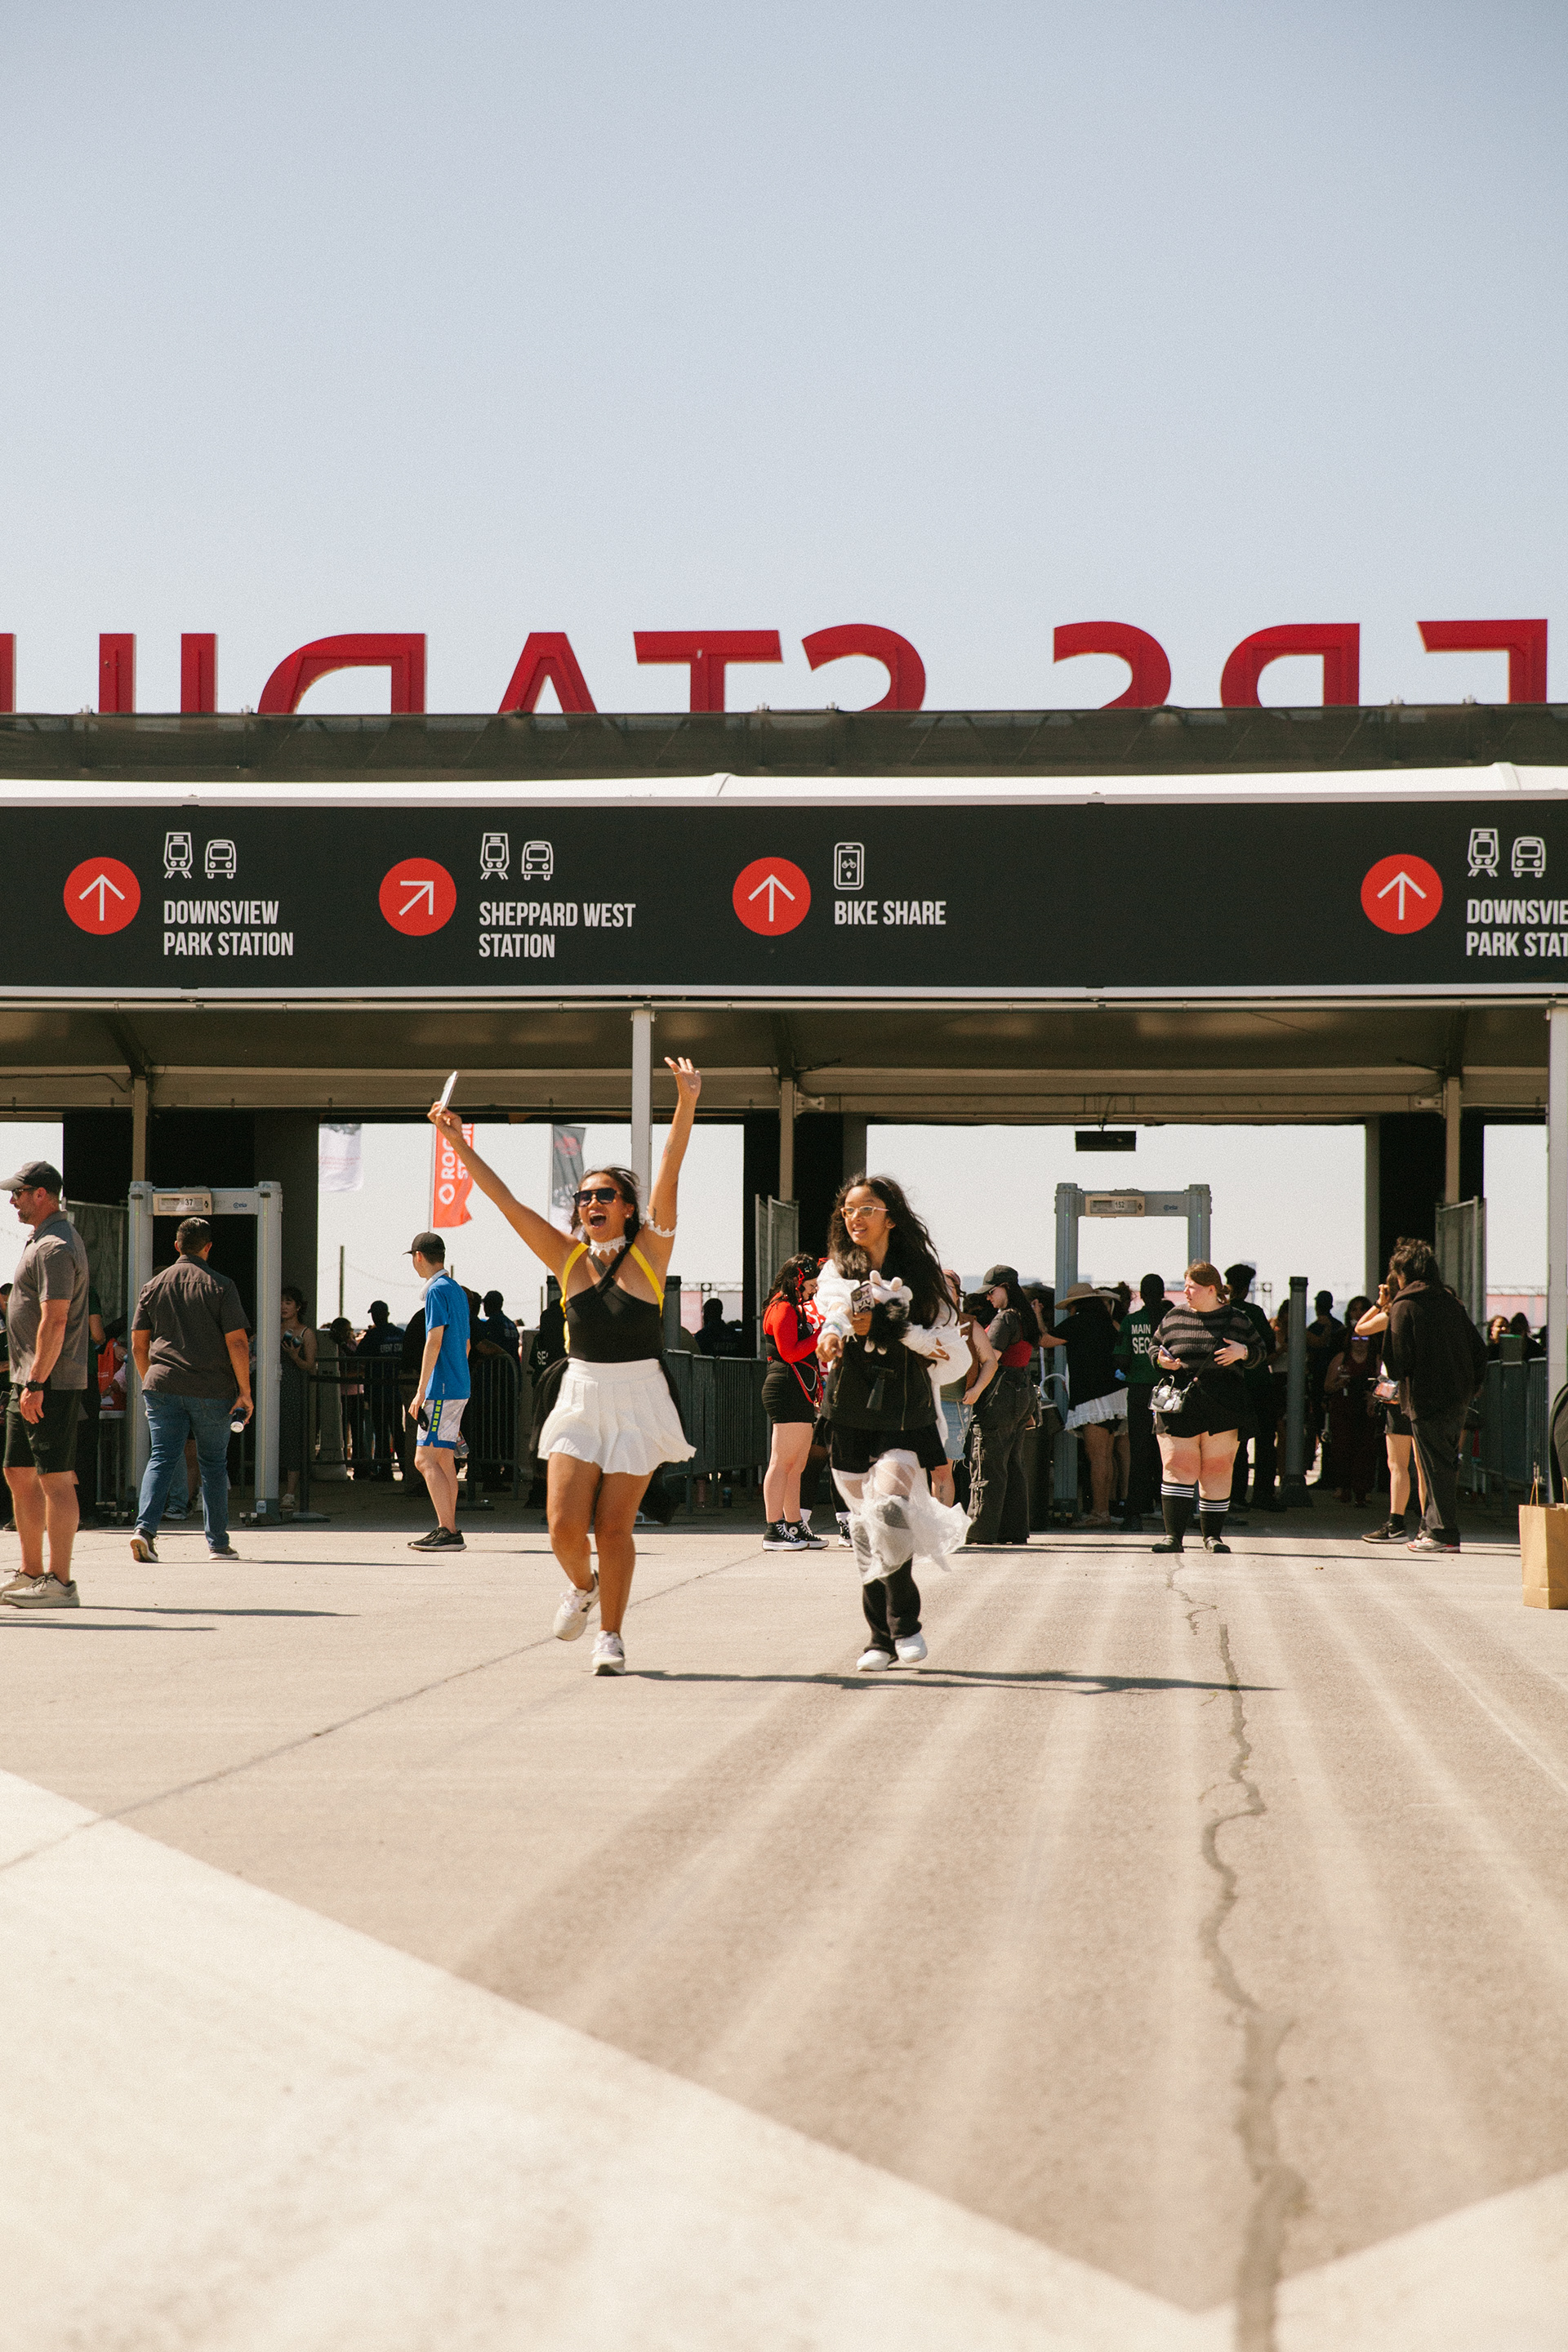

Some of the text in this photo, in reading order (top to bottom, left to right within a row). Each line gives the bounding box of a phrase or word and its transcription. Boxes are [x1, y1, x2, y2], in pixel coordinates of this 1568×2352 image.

[163, 900, 279, 924] DOWNSVIEW
[479, 901, 636, 928] SHEPPARD WEST
[834, 900, 947, 925] BIKE SHARE
[163, 931, 294, 956] PARK STATION
[479, 933, 555, 958] STATION
[1466, 931, 1520, 957] PARK
[185, 1198, 194, 1206] 37
[1131, 1323, 1152, 1334] MAIN
